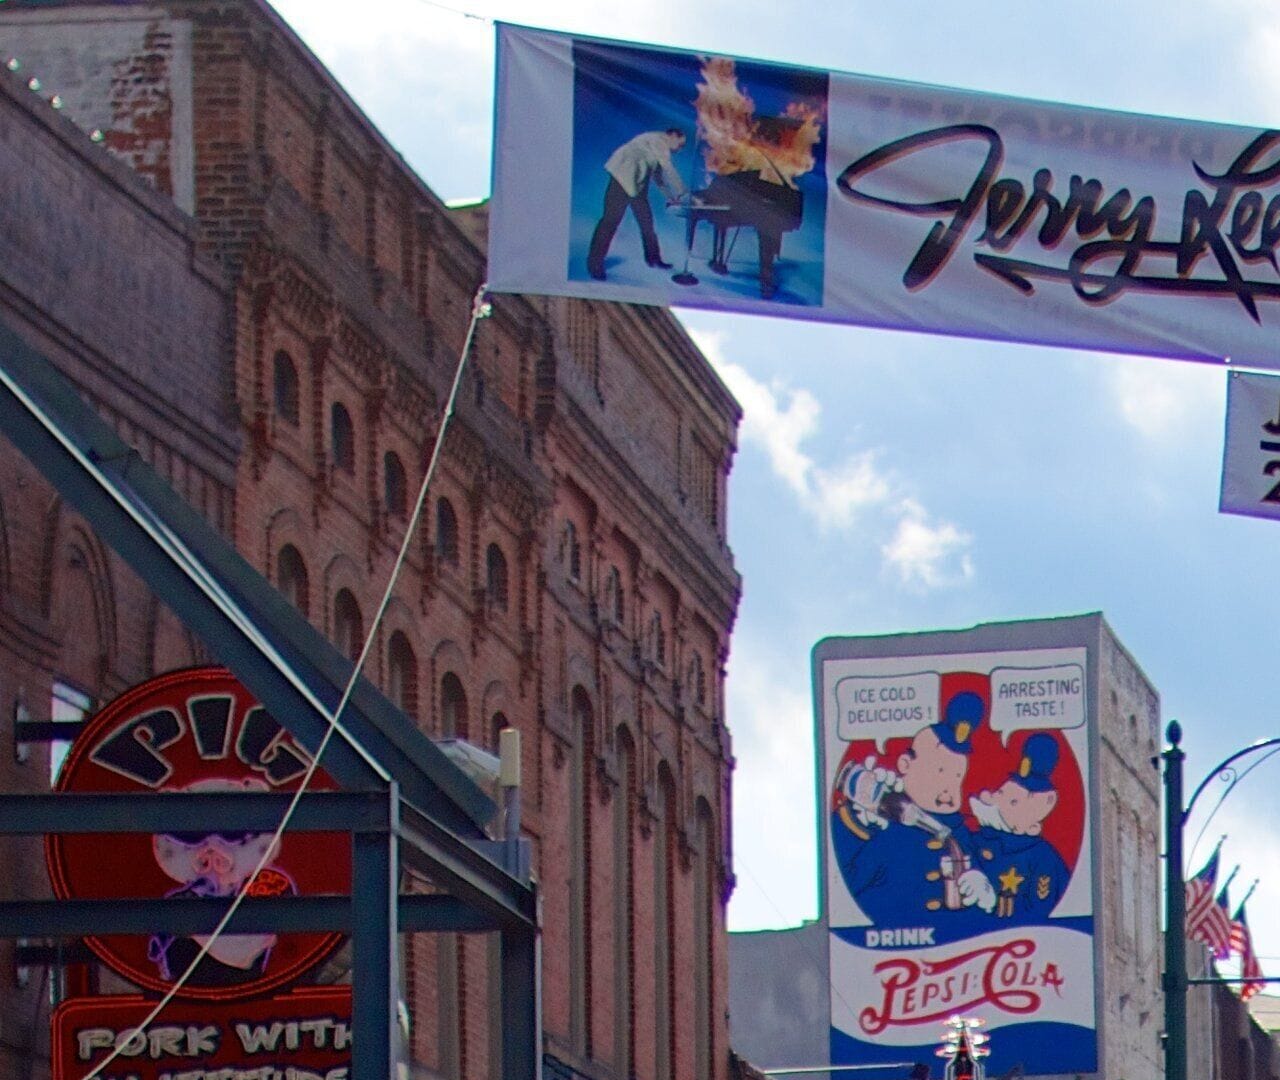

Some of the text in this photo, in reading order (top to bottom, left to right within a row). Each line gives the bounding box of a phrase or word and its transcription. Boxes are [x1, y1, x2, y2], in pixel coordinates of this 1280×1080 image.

[837, 124, 1162, 306] Jerry
[854, 686, 916, 703] ICE COLD
[999, 677, 1080, 699] ARRESTING
[91, 694, 315, 789] PIG
[866, 926, 936, 948] DRINK
[77, 1019, 352, 1060] PORK WITH
